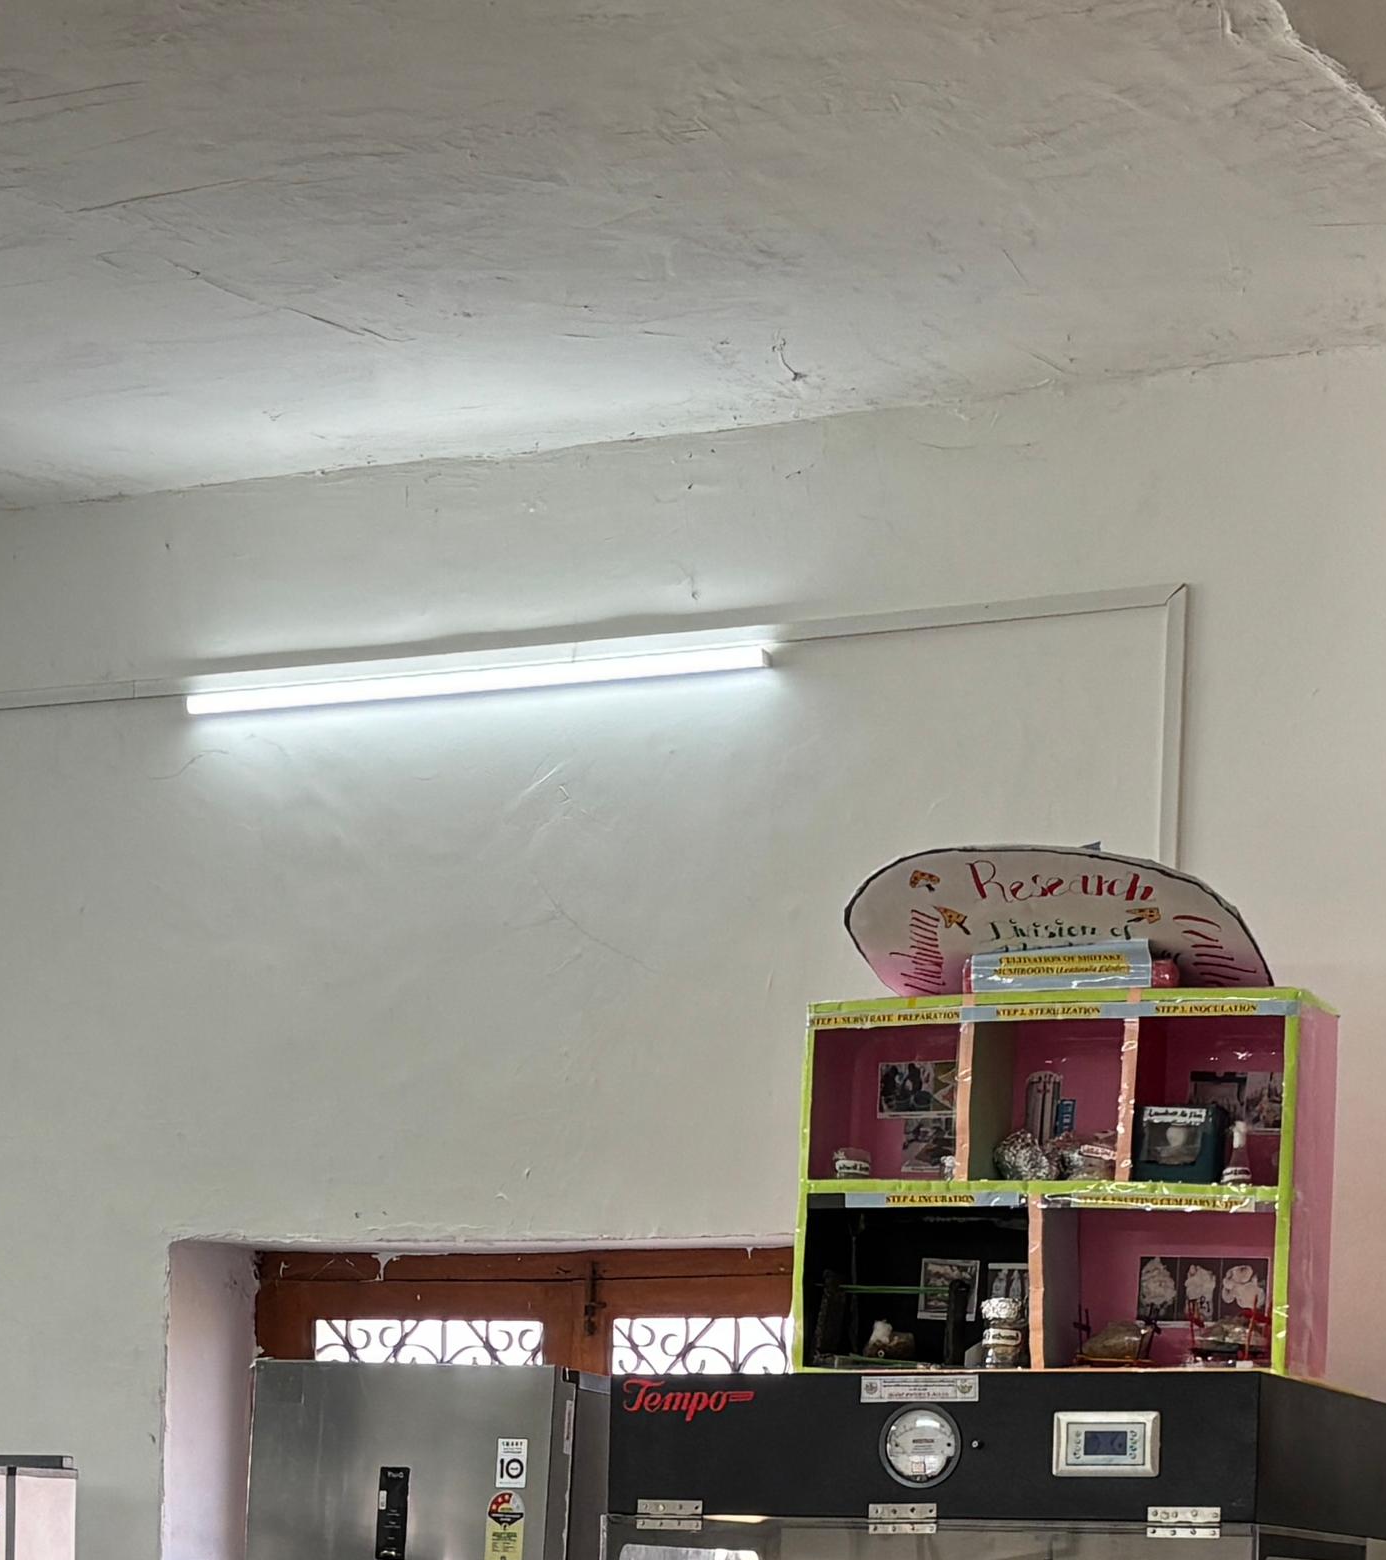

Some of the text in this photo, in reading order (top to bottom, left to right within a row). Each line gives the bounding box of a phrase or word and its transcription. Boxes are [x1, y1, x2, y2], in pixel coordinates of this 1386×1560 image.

[965, 860, 1154, 902] Research
[623, 1378, 755, 1422] Tempo
[500, 1458, 524, 1479] 10
